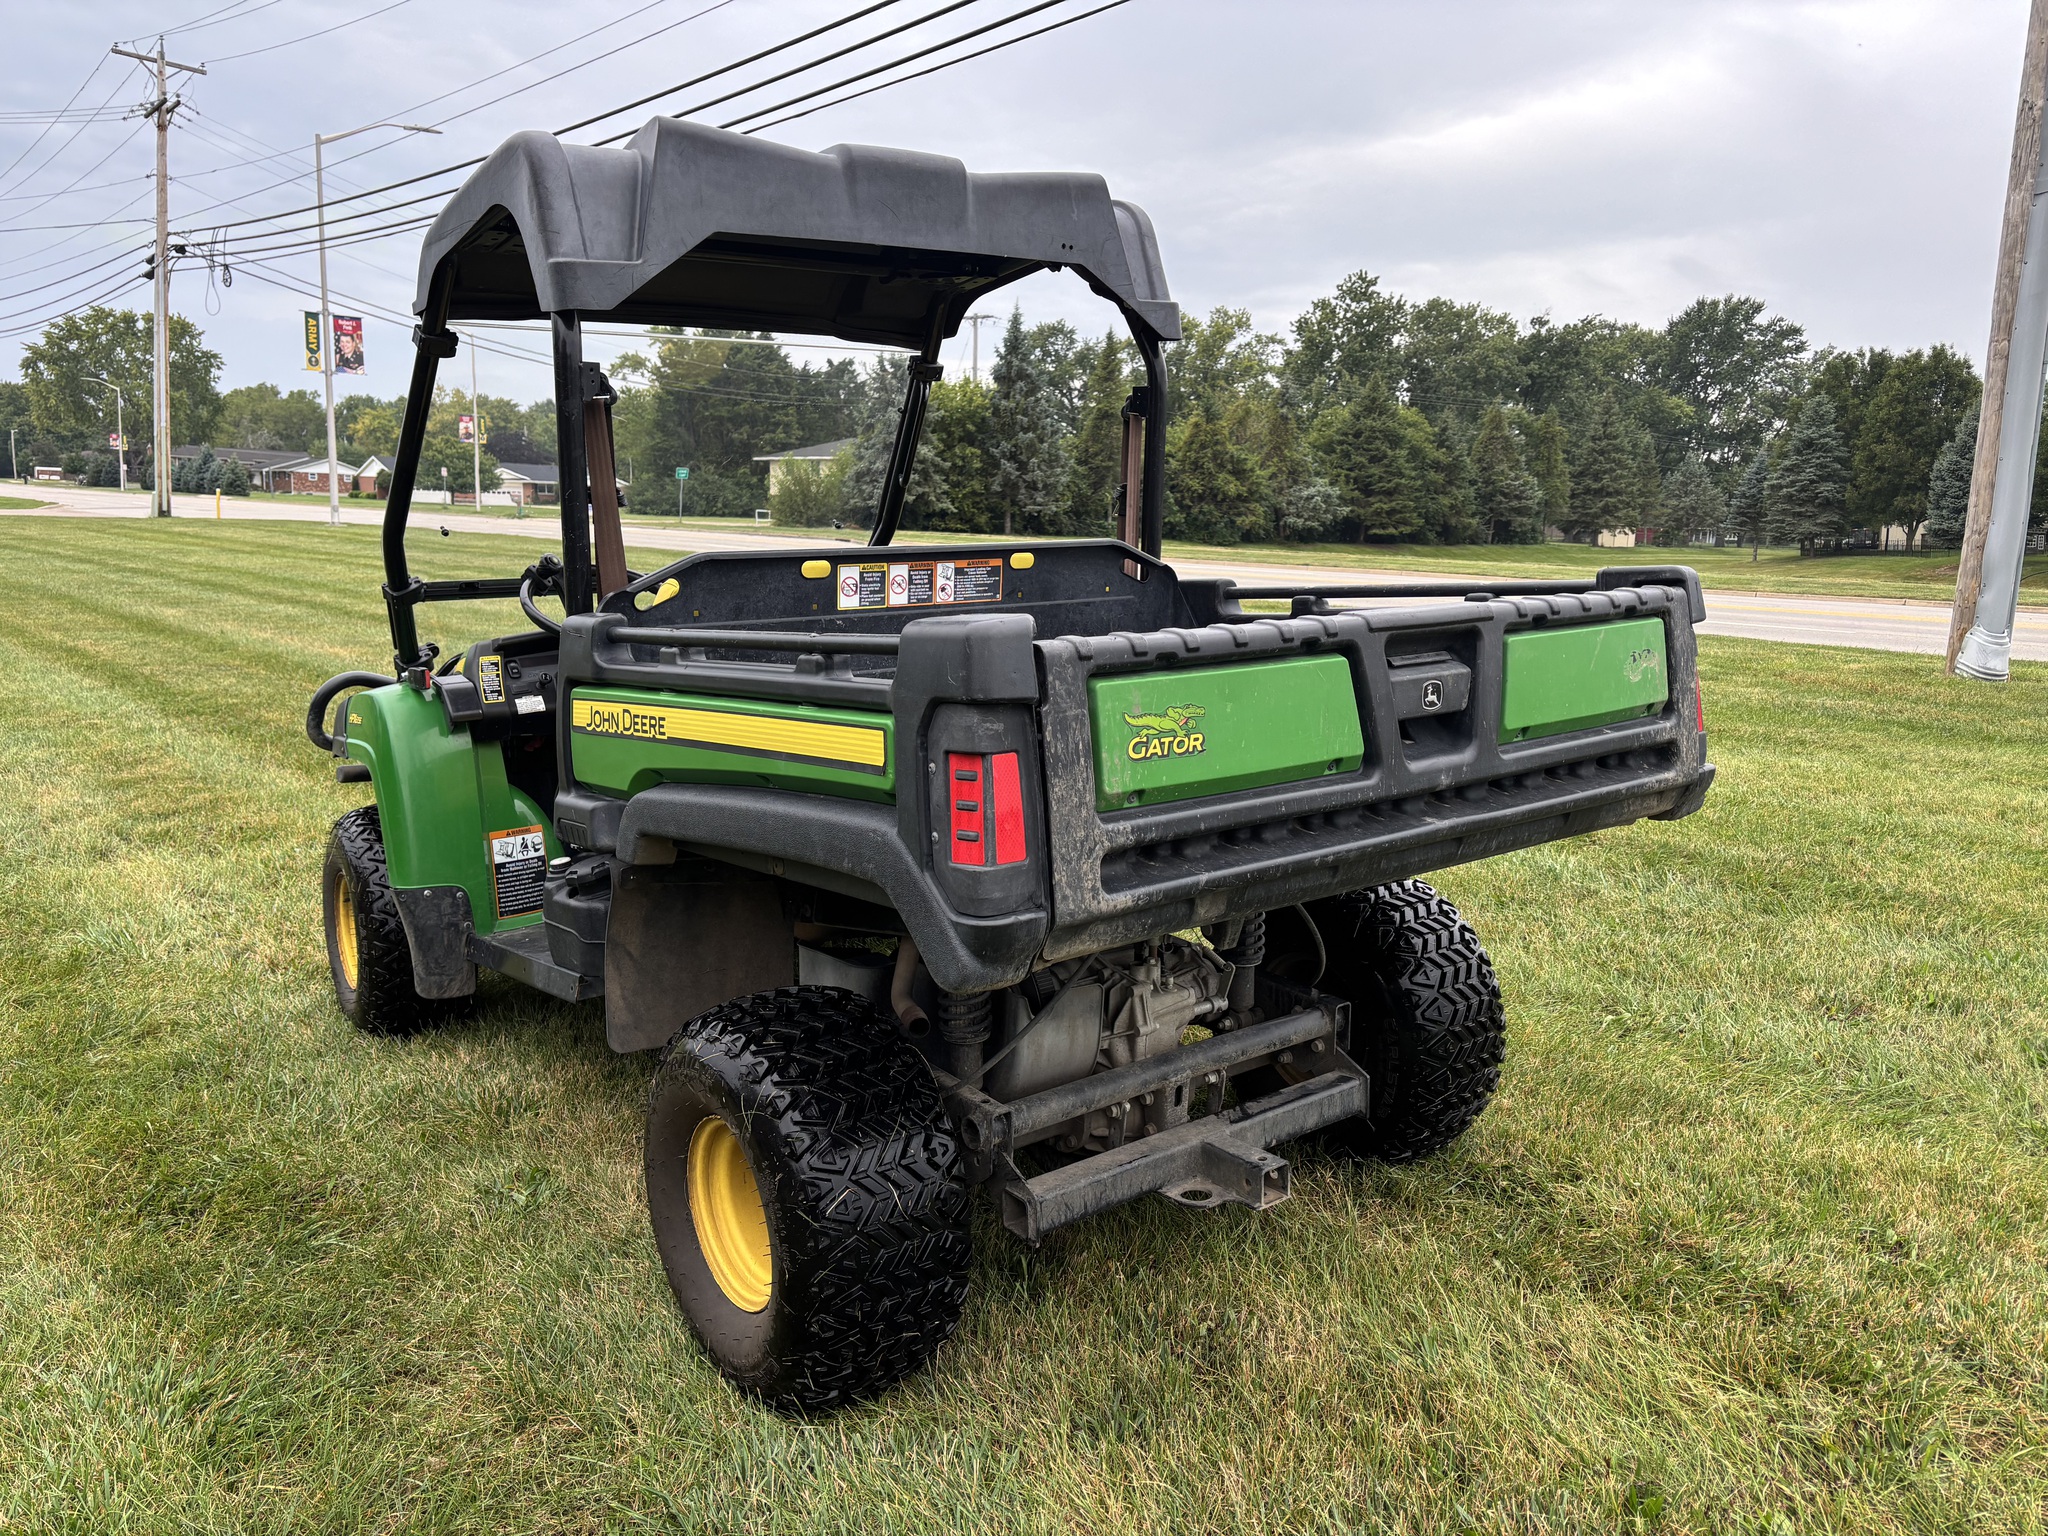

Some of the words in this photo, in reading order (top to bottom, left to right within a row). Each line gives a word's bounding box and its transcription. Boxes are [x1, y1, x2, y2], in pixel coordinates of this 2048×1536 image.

[307, 318, 318, 351] ARMY
[586, 705, 620, 731] JOHN
[622, 708, 667, 737] DEERE
[1127, 733, 1205, 761] GATOR
[511, 827, 532, 836] WARNING
